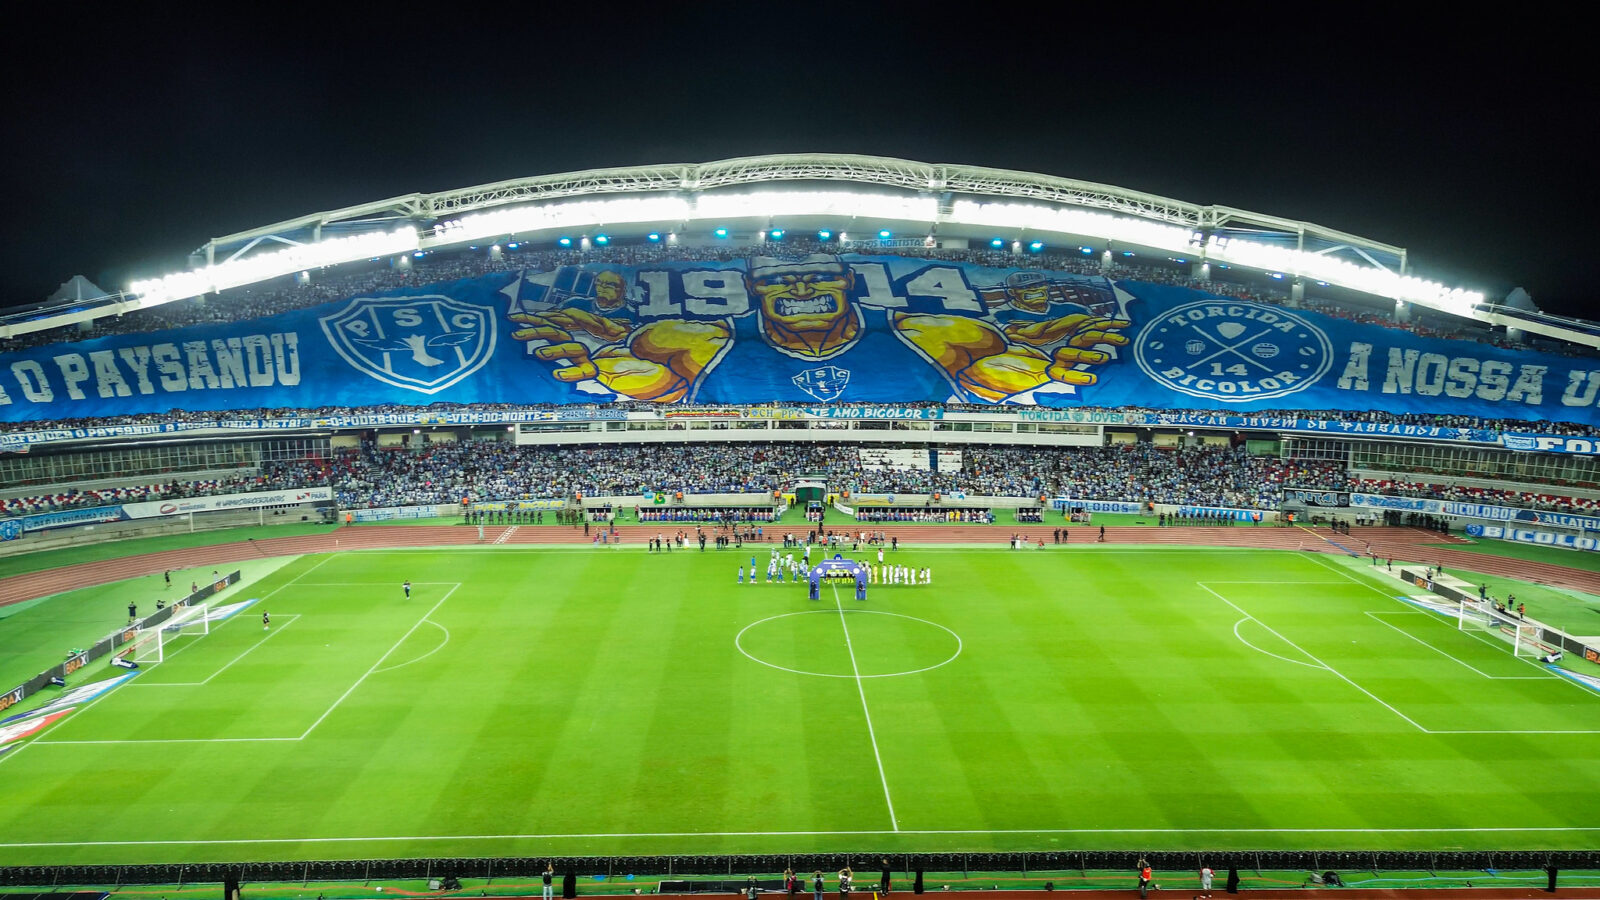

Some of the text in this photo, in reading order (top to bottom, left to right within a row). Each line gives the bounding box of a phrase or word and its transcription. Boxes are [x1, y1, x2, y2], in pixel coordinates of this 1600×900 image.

[639, 263, 982, 317] 19 14
[1168, 306, 1296, 333] TORCIDA
[11, 332, 301, 402] O PAYSANDU
[1210, 362, 1248, 376] 14
[1337, 341, 1600, 407] A NOSSA U
[1161, 366, 1302, 393] BICOLOR
[811, 408, 829, 418] TE
[864, 408, 922, 419] BICOLOR
[1020, 410, 1124, 423] TORCIDA JOVEM
[0, 429, 74, 445] DEFENDER
[1535, 437, 1600, 453] FO
[66, 654, 87, 674] BRAX
